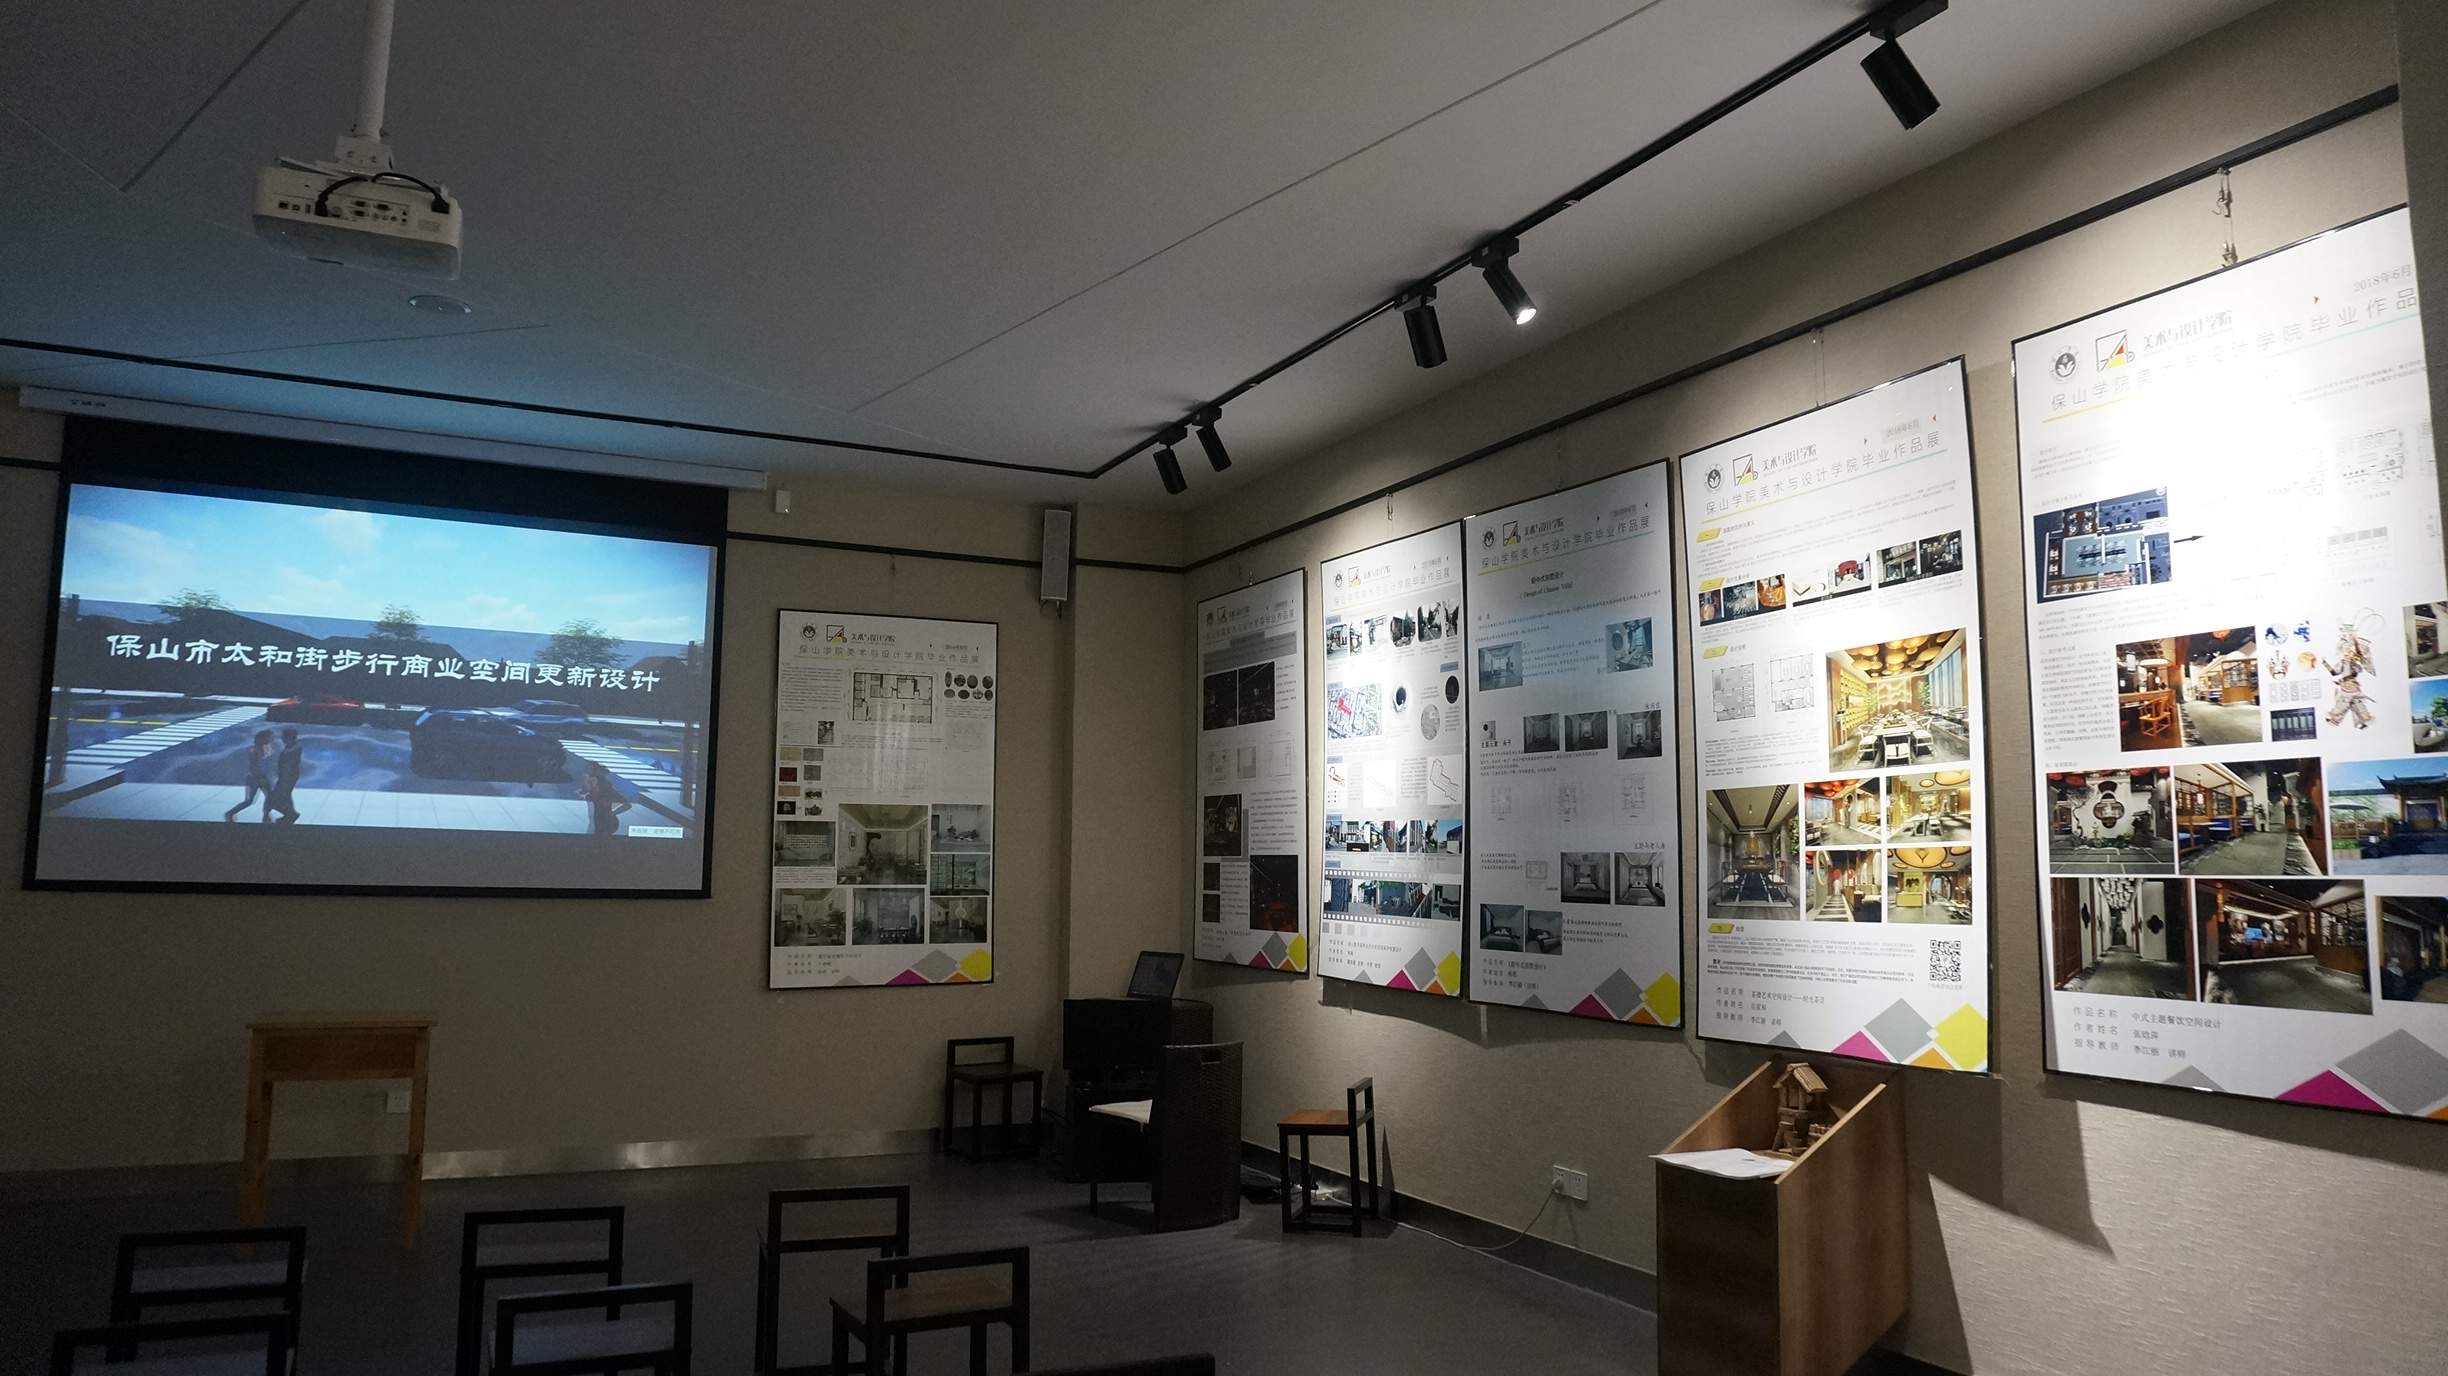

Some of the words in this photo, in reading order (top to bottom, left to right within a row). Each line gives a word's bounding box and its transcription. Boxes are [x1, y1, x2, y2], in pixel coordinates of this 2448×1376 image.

[107, 633, 661, 692] 保山市太和街步行商业空间更新设计
